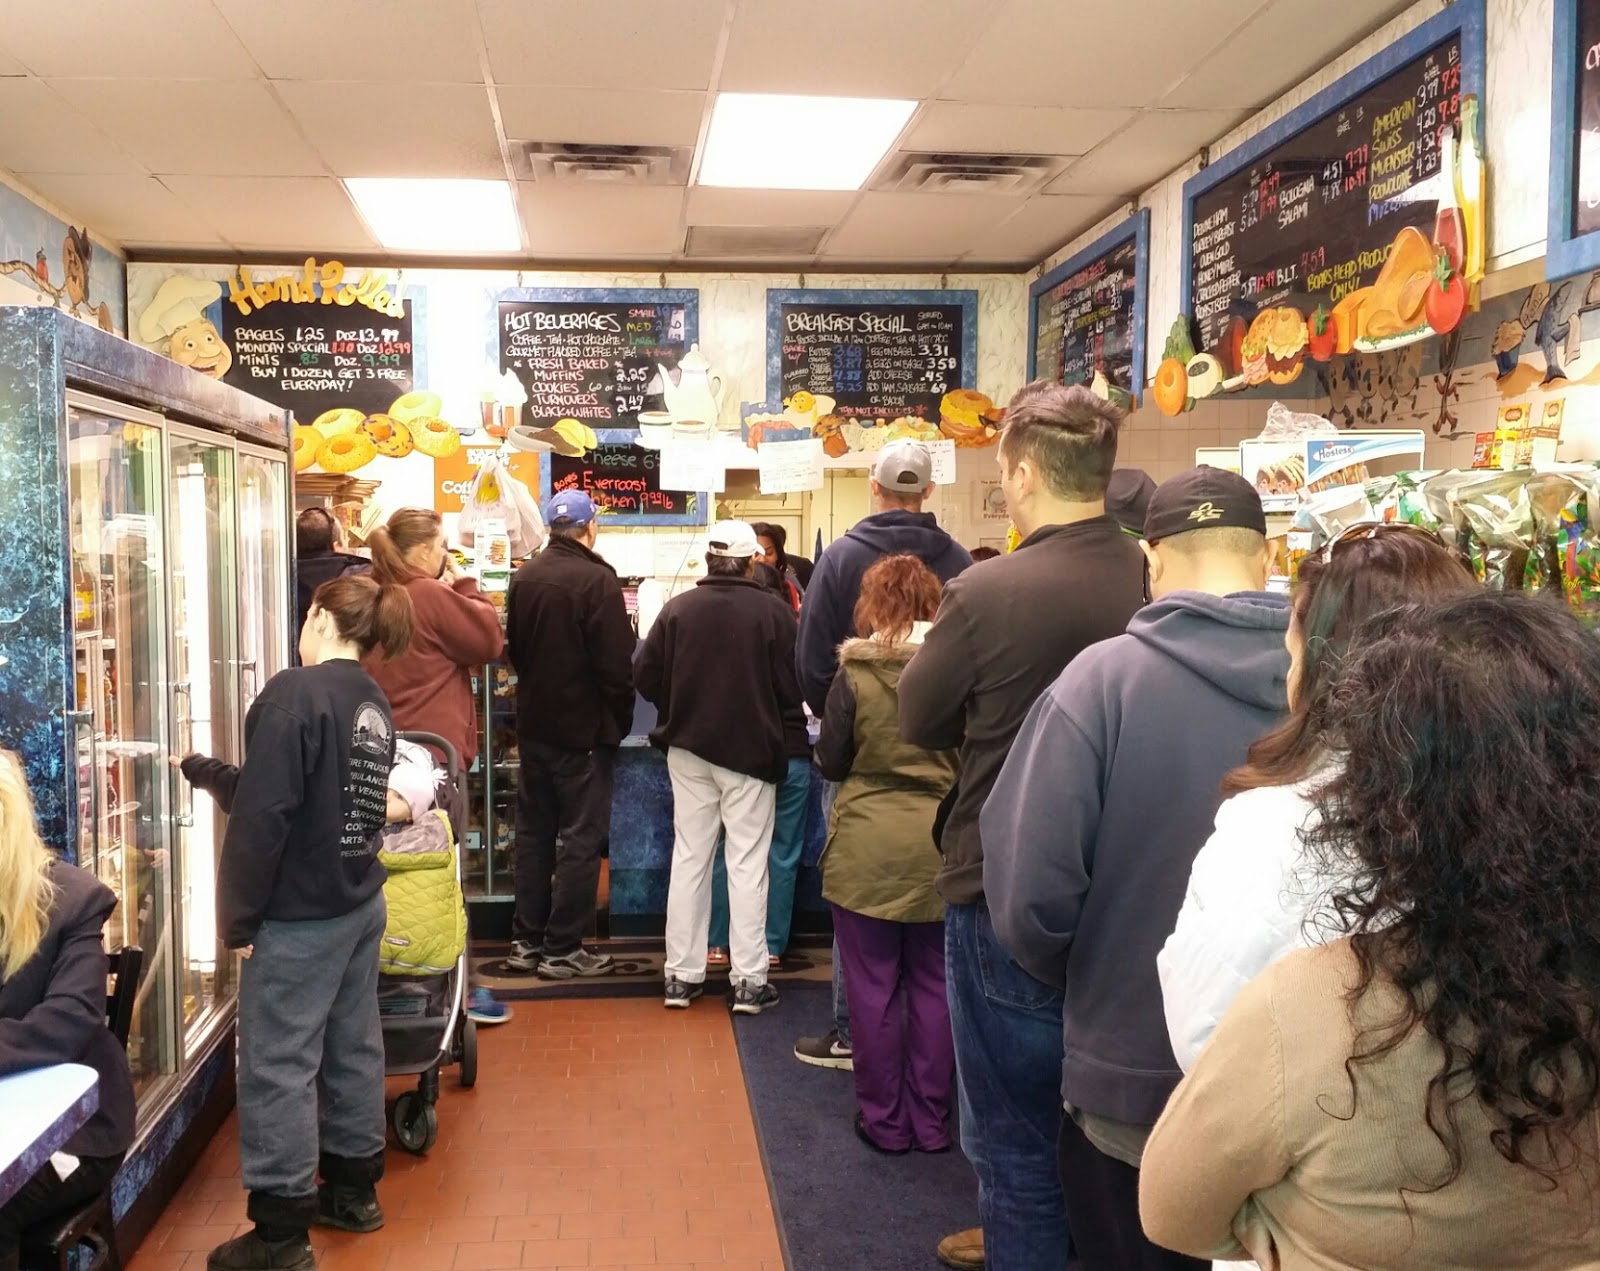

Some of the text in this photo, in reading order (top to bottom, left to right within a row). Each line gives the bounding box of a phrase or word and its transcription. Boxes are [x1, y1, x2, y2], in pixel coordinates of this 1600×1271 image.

[1279, 174, 1315, 209] BOLOGNA
[1333, 260, 1358, 281] HEAD
[228, 257, 316, 316] Hand
[628, 309, 657, 318] SMALL
[504, 311, 621, 332] HOT BEVERAGES
[626, 322, 652, 332] MED
[786, 312, 912, 333] BREAKFAST SPECIAL
[235, 327, 285, 342] BAGELS
[512, 334, 542, 346] COFFEE
[546, 333, 562, 345] TEA
[567, 333, 583, 345] HOT
[784, 334, 797, 344] ALL
[843, 334, 850, 343] A
[235, 341, 284, 353] MONDAY
[287, 341, 332, 354] SPECIAL
[505, 345, 546, 358] GOURMET
[582, 346, 612, 358] COFFEE
[782, 345, 807, 354] BAGEL
[871, 347, 884, 356] EGG
[893, 346, 916, 357] BAGEL
[918, 344, 949, 357] 3.31
[362, 353, 400, 367] 9.99
[528, 358, 609, 370] FRESH BAKED
[873, 358, 892, 369] EGGS
[902, 359, 925, 370] BAGEL
[251, 366, 277, 378] BUY
[290, 367, 333, 378] DOZEN
[338, 368, 362, 379] GET
[365, 368, 376, 379] 3
[377, 368, 407, 380] FREE
[534, 370, 585, 381] MUFFINS
[867, 370, 882, 381] ADD
[883, 370, 913, 381] CHEESE
[532, 381, 580, 394] COOKIES
[866, 382, 879, 393] ADD
[533, 392, 598, 406] TURNOVERS
[581, 450, 637, 468] Cheese
[1318, 446, 1352, 460] Hostess
[583, 470, 646, 491] Everroast
